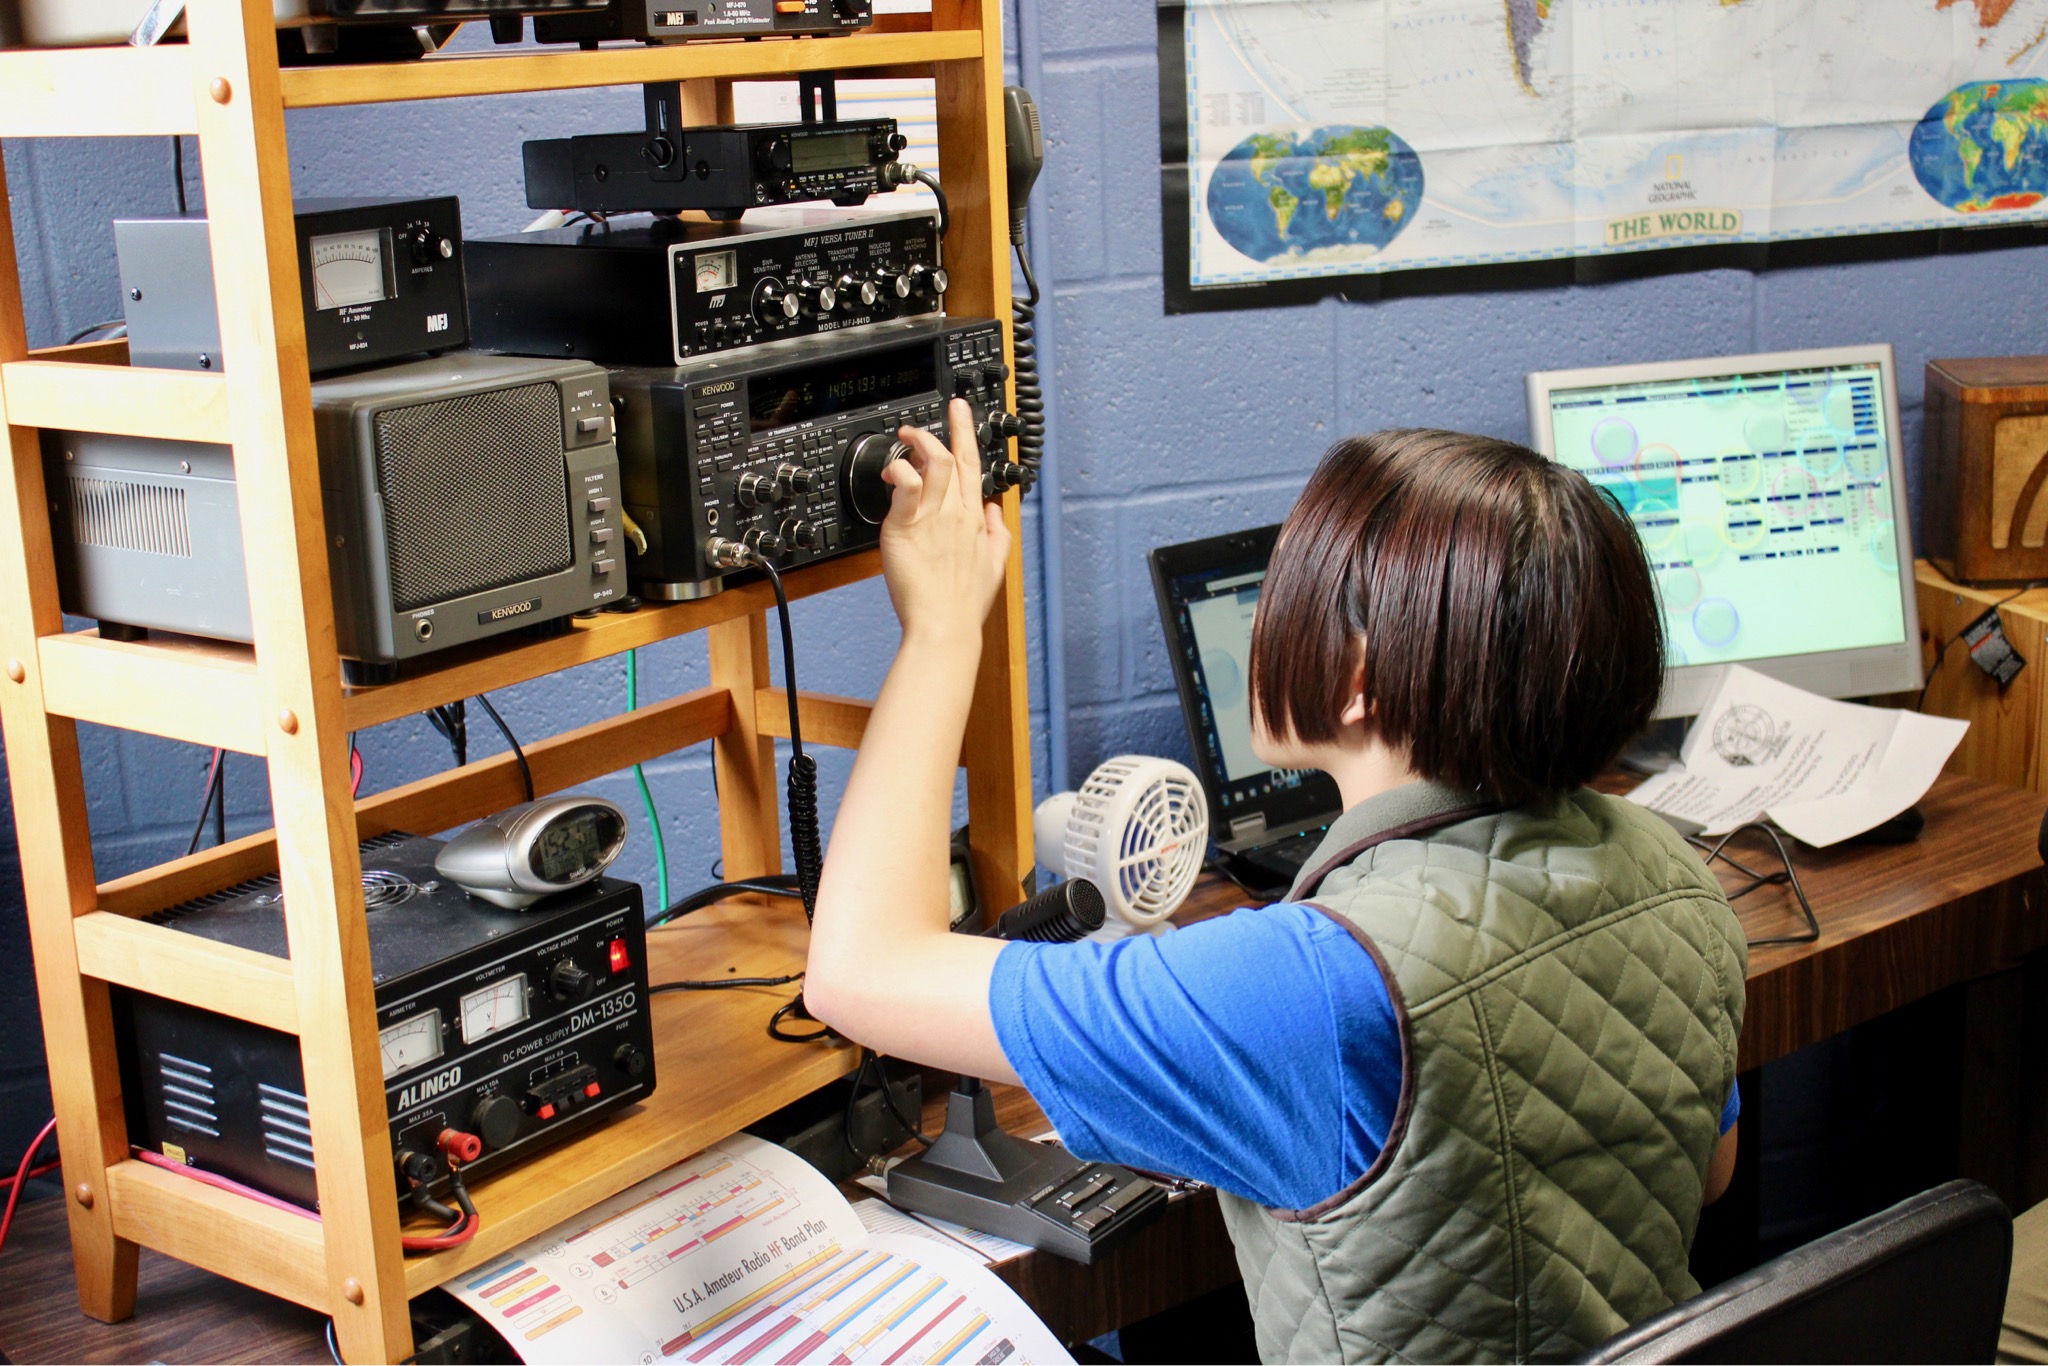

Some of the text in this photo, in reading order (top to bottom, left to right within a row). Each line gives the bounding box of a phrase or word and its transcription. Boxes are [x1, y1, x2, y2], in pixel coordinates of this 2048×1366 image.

[667, 13, 684, 26] MFJ
[704, 16, 770, 26] Peak Reading SWR/Wattmeter
[1653, 181, 1691, 193] NATIONAL
[1648, 190, 1697, 204] GEOGRAPHIC
[1609, 211, 1738, 241] THE WORLD
[804, 229, 874, 248] MFJ VERSA TUNER II
[828, 247, 858, 256] TRANSMITTER
[868, 242, 891, 250] INDUCTOR
[795, 252, 817, 260] ANTENNA
[869, 248, 891, 256] SELECTOR
[794, 259, 818, 268] SELECTOR
[831, 254, 856, 262] MATCHING
[412, 266, 433, 274] AMPERES
[753, 264, 782, 274] SENSITIVITY
[340, 305, 372, 316] RF Ammeter
[427, 313, 448, 333] MFJ
[818, 316, 870, 332] MODEL MFJ-941D
[578, 390, 593, 398] INPUT
[702, 382, 735, 396] KENWOOD
[773, 426, 797, 435] TRANSCEIVER
[585, 474, 604, 482] FILTERS
[704, 500, 719, 508] PHONES
[593, 589, 613, 599] SP-940
[412, 608, 434, 619] PHONES
[492, 602, 531, 620] KENWOOD
[606, 917, 624, 928] POWER
[537, 935, 579, 957] VOLTAGE ADJUST
[596, 940, 604, 948] ON
[475, 965, 506, 982] VOLTMETER
[596, 977, 607, 986] OFF
[389, 1002, 416, 1017] AMMETER
[502, 991, 635, 1063] DC POWER SUPPLY DM-1350
[616, 1021, 629, 1031] FUSE
[544, 1054, 555, 1063] MAX
[397, 1066, 462, 1111] ALINCO
[476, 1079, 499, 1093] MAX 10A
[408, 1114, 421, 1124] MAX
[673, 1288, 706, 1313] U.S.A.
[704, 1267, 745, 1296] Amateur
[741, 1250, 771, 1274] Radio
[767, 1240, 783, 1259] HF
[780, 1226, 806, 1251] Band
[804, 1218, 828, 1240] Plan
[643, 1354, 652, 1365] 10
